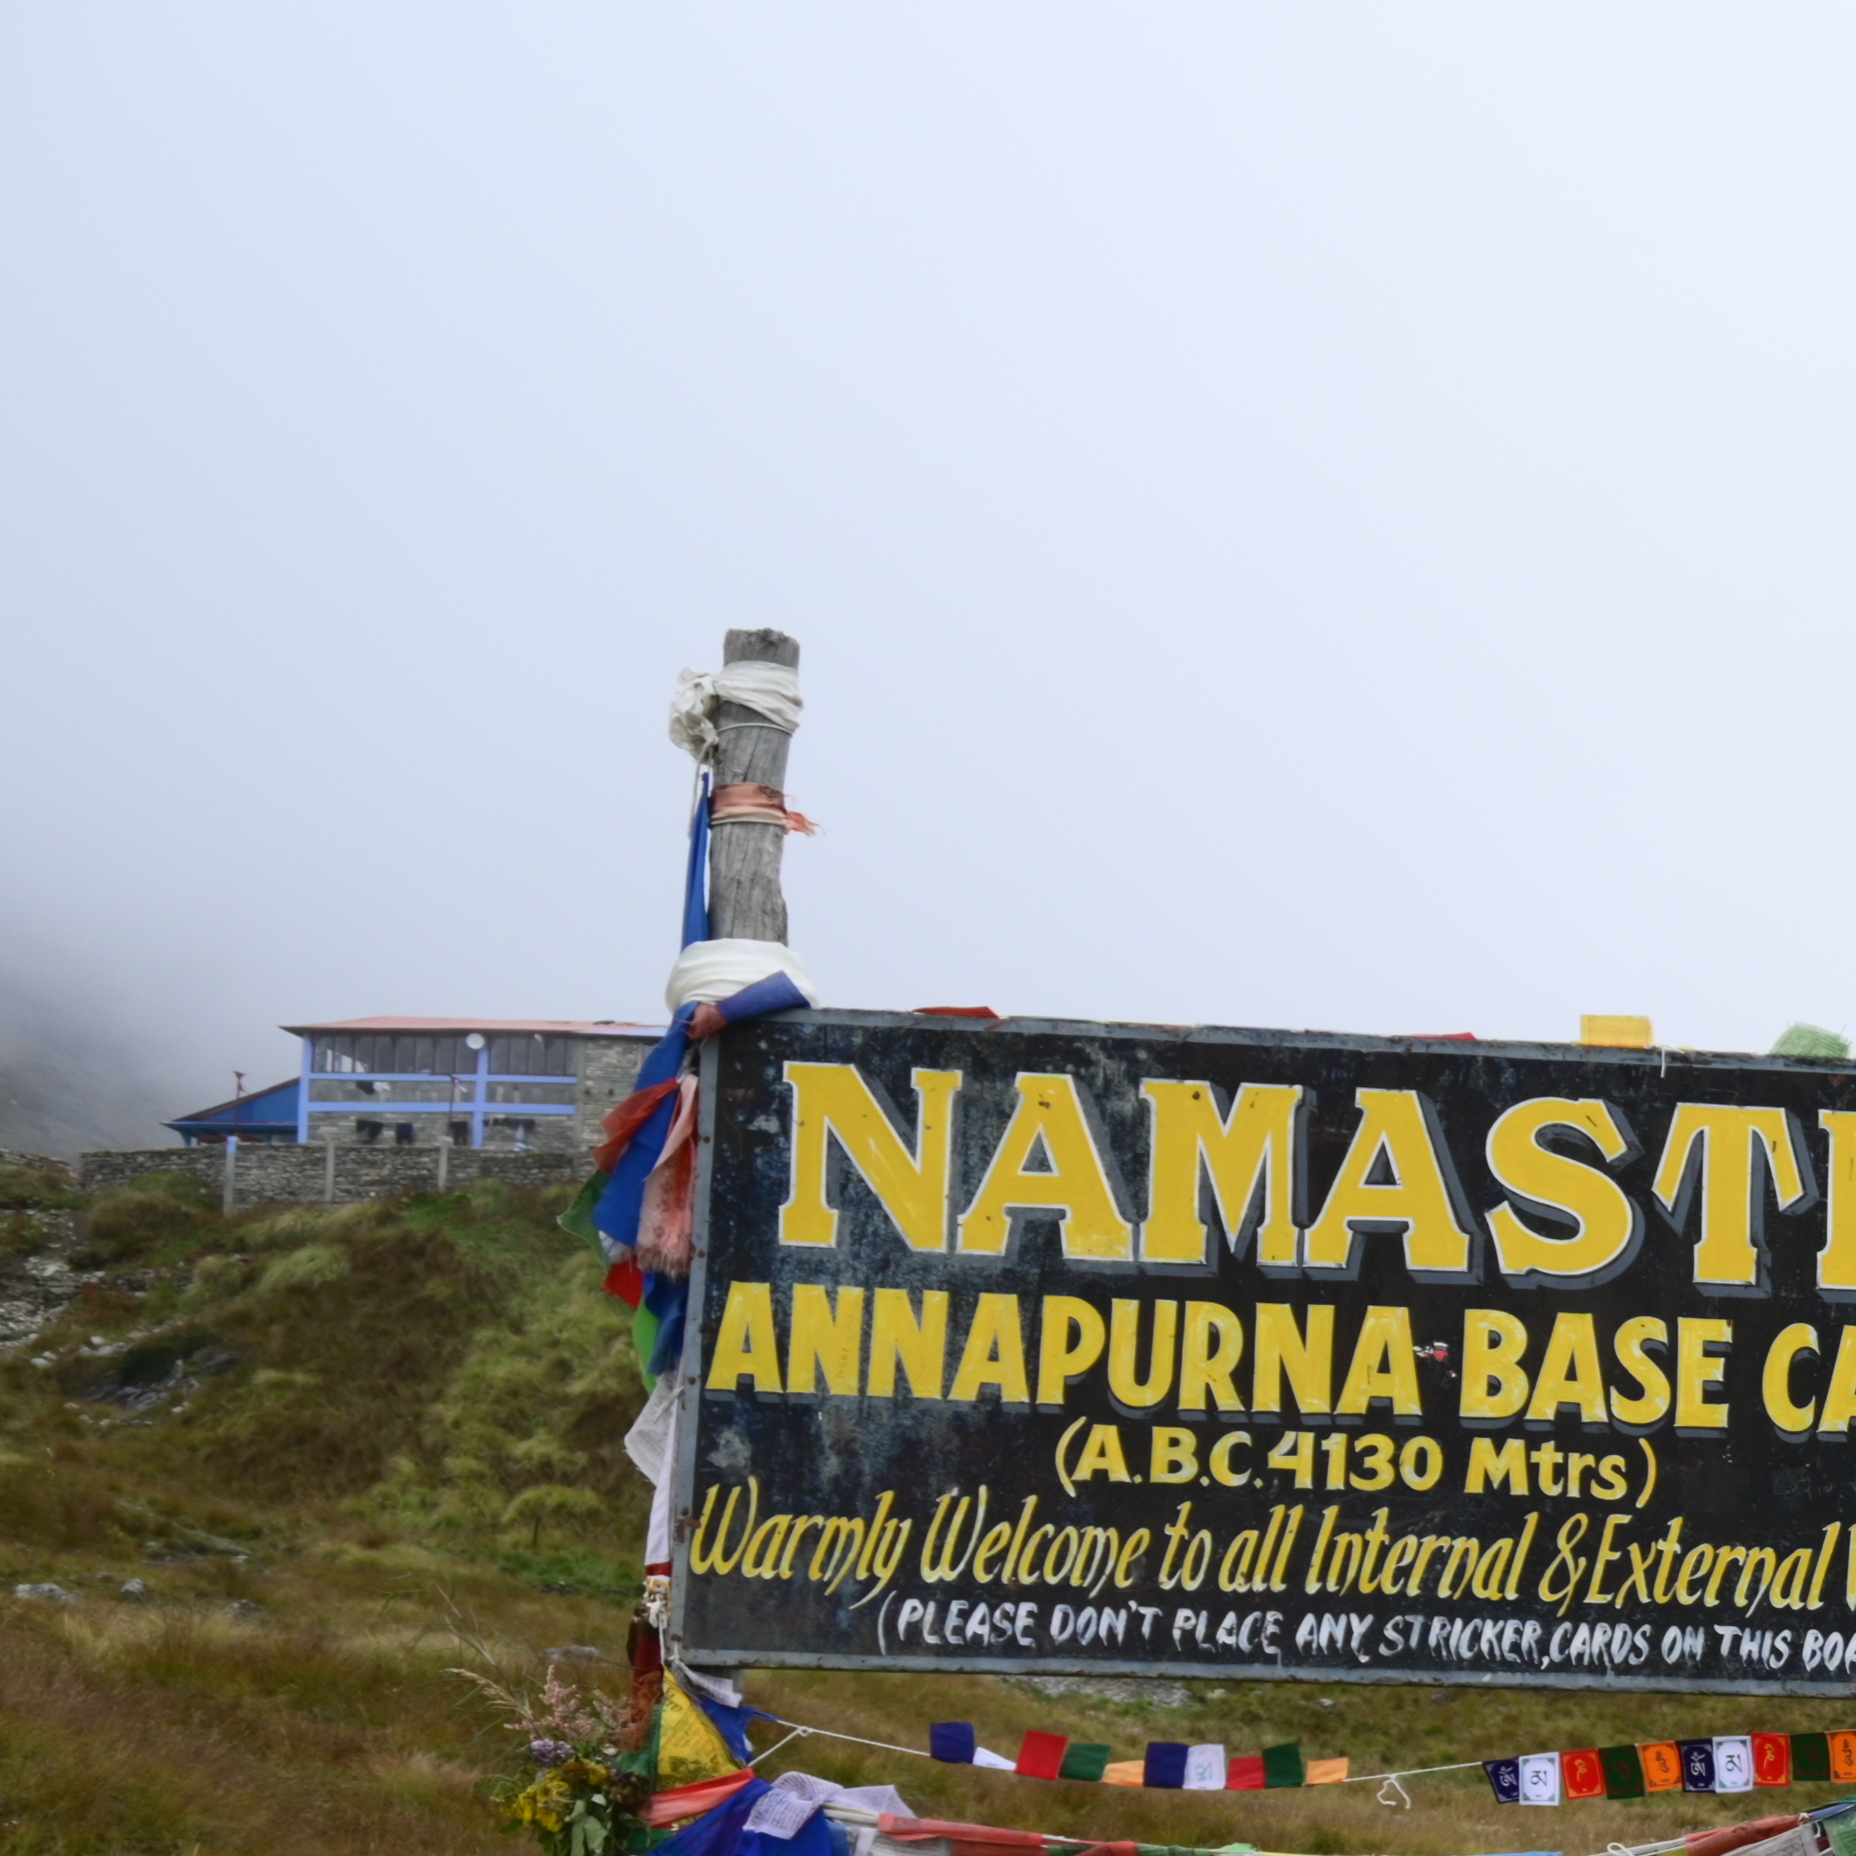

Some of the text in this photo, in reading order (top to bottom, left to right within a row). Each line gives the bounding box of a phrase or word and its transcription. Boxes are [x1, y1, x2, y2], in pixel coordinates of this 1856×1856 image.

[704, 1279, 1422, 1417] ANNAPURNA
[1459, 1308, 1733, 1430] BASE
[1464, 1437, 1656, 1508] Mtrs)
[689, 1476, 912, 1609] Warmly
[921, 1485, 1150, 1598] Welcome
[1160, 1502, 1212, 1593] to
[1219, 1504, 1303, 1594] all
[1306, 1505, 1539, 1601] Internal
[877, 1590, 1037, 1656] (PLEASE
[1051, 1600, 1163, 1649] DON'T
[1174, 1608, 1284, 1656] PLACE
[1296, 1612, 1373, 1663] ANY
[1661, 1625, 1705, 1666] ON
[1714, 1624, 1790, 1670] THIS
